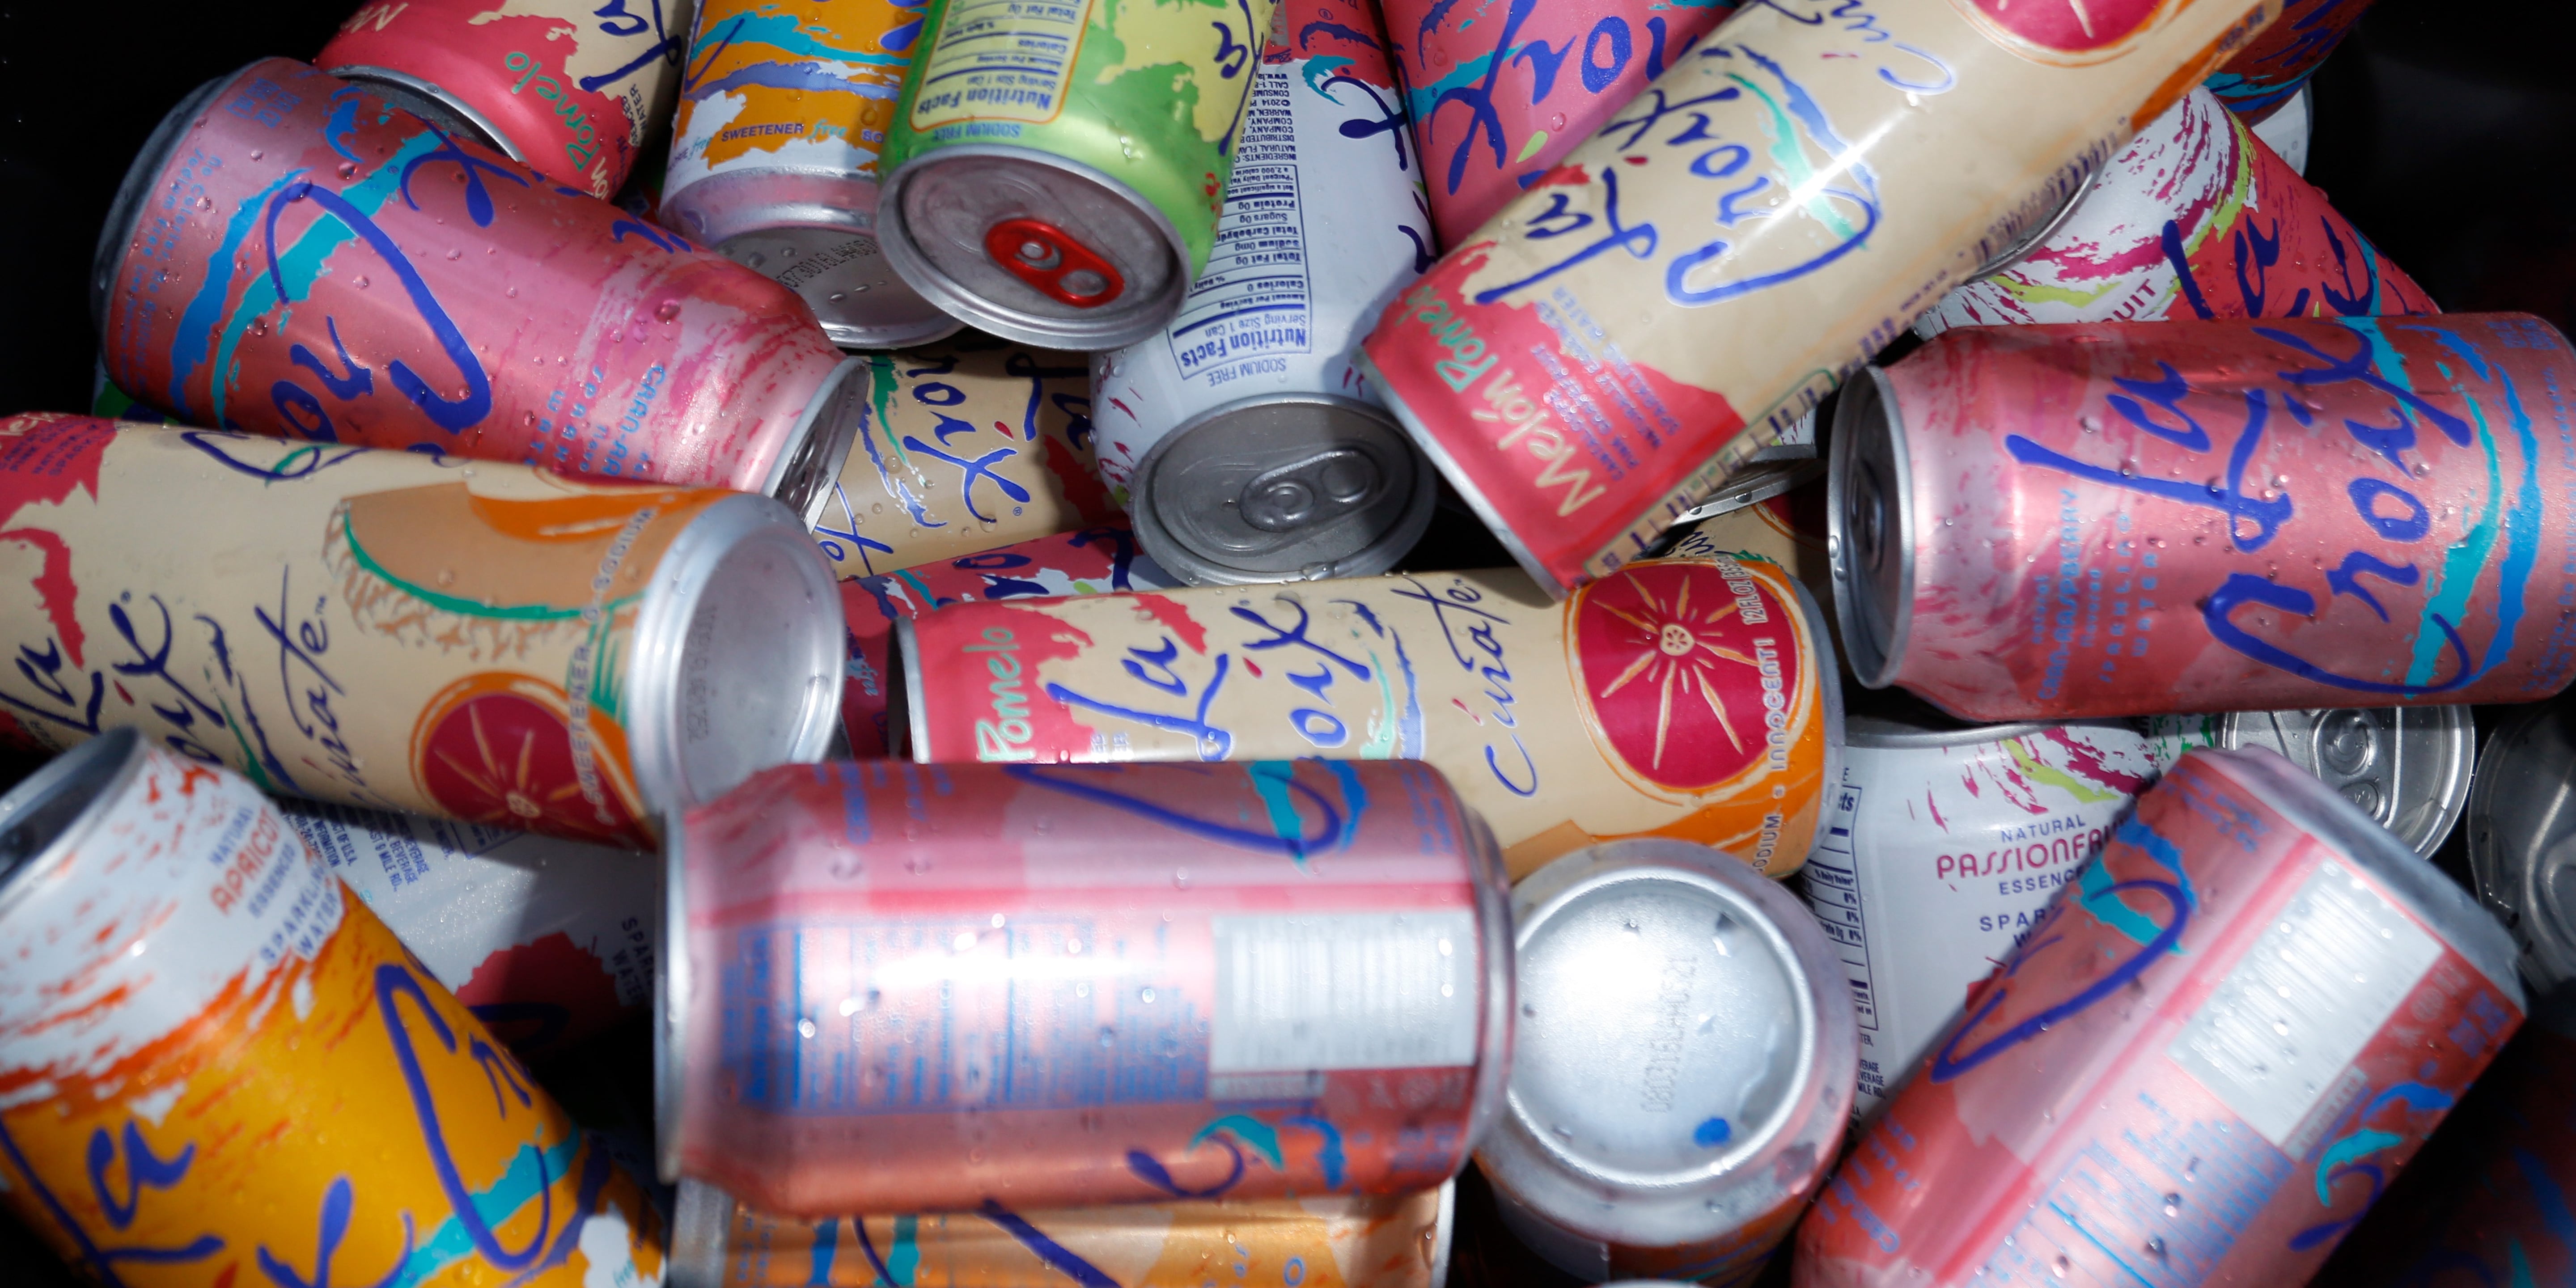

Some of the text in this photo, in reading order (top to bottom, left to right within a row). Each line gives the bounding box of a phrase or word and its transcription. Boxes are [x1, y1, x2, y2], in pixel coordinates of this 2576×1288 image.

[966, 89, 1052, 111] Nutrition
[505, 52, 598, 171] Pomelo
[721, 123, 804, 142] SWEETENER
[807, 119, 847, 140] free
[1246, 135, 1294, 143] DISTRIBUTED
[1243, 153, 1296, 162] INGREDIENTS:
[1259, 145, 1296, 153] NATURAL
[1238, 200, 1295, 210] Protein 0g
[1240, 212, 1288, 224] Sugars 0g
[1272, 226, 1298, 235] Total
[1474, 167, 1657, 304] La
[1235, 240, 1300, 251] Sodium 0mg
[1236, 253, 1301, 266] Total Fat 0g
[1257, 280, 1304, 291] Calories
[1205, 325, 1225, 337] Can
[1238, 318, 1261, 328] Size
[1264, 314, 1306, 326] Serving
[1181, 328, 1306, 366] Nutrition Facts
[1207, 358, 1286, 387] SODIUM FREE
[553, 365, 603, 463] SPARK
[1472, 369, 1606, 517] Melón
[2005, 361, 2293, 553] La
[962, 625, 1036, 764] Pomelo
[1045, 636, 1234, 763] La
[2000, 814, 2087, 843] NATURAL
[1753, 812, 1783, 873] ODIUM
[379, 850, 397, 874] MILE
